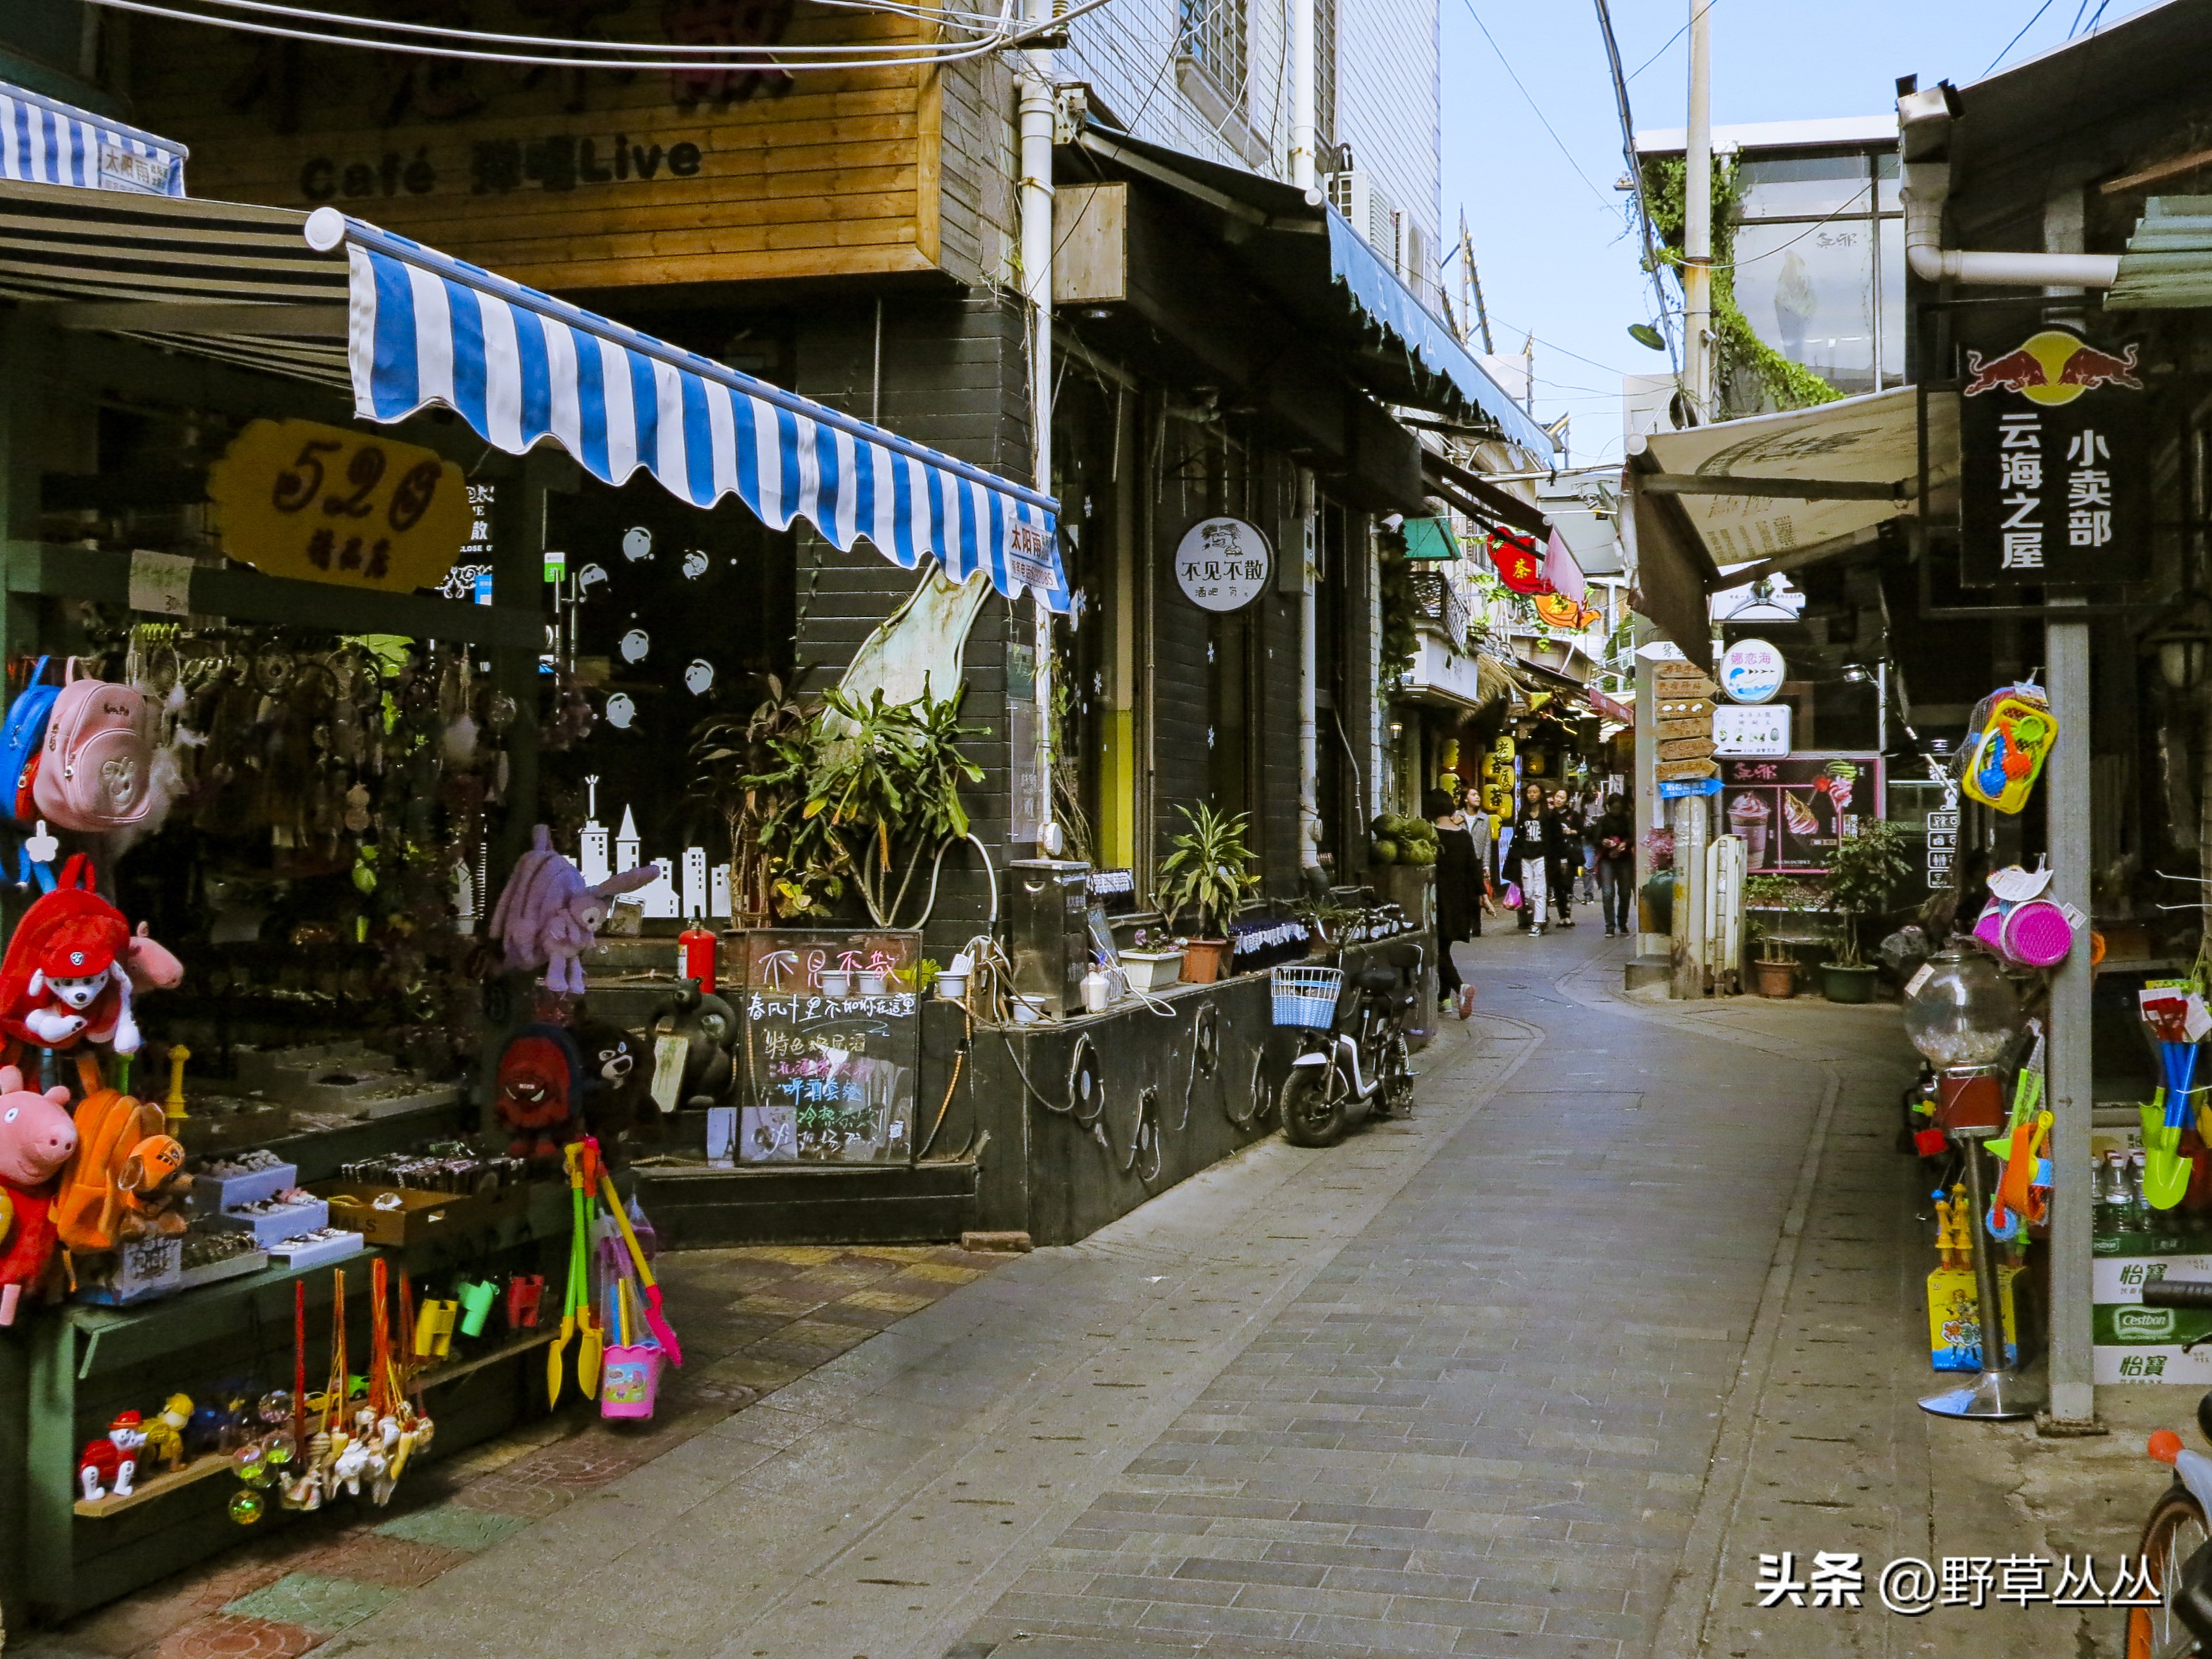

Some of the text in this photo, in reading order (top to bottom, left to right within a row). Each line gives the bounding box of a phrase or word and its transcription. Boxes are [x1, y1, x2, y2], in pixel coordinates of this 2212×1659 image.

[106, 149, 149, 183] 太阳雨
[1999, 413, 2044, 569] 云海之屋
[2067, 429, 2112, 547] 小卖部
[1012, 523, 1041, 558] 太阳雨
[1181, 560, 1264, 581] 不见不散
[1512, 558, 1532, 578] 茶
[2122, 1315, 2166, 1326] Cestbon
[2119, 1355, 2168, 1377] 怡寶
